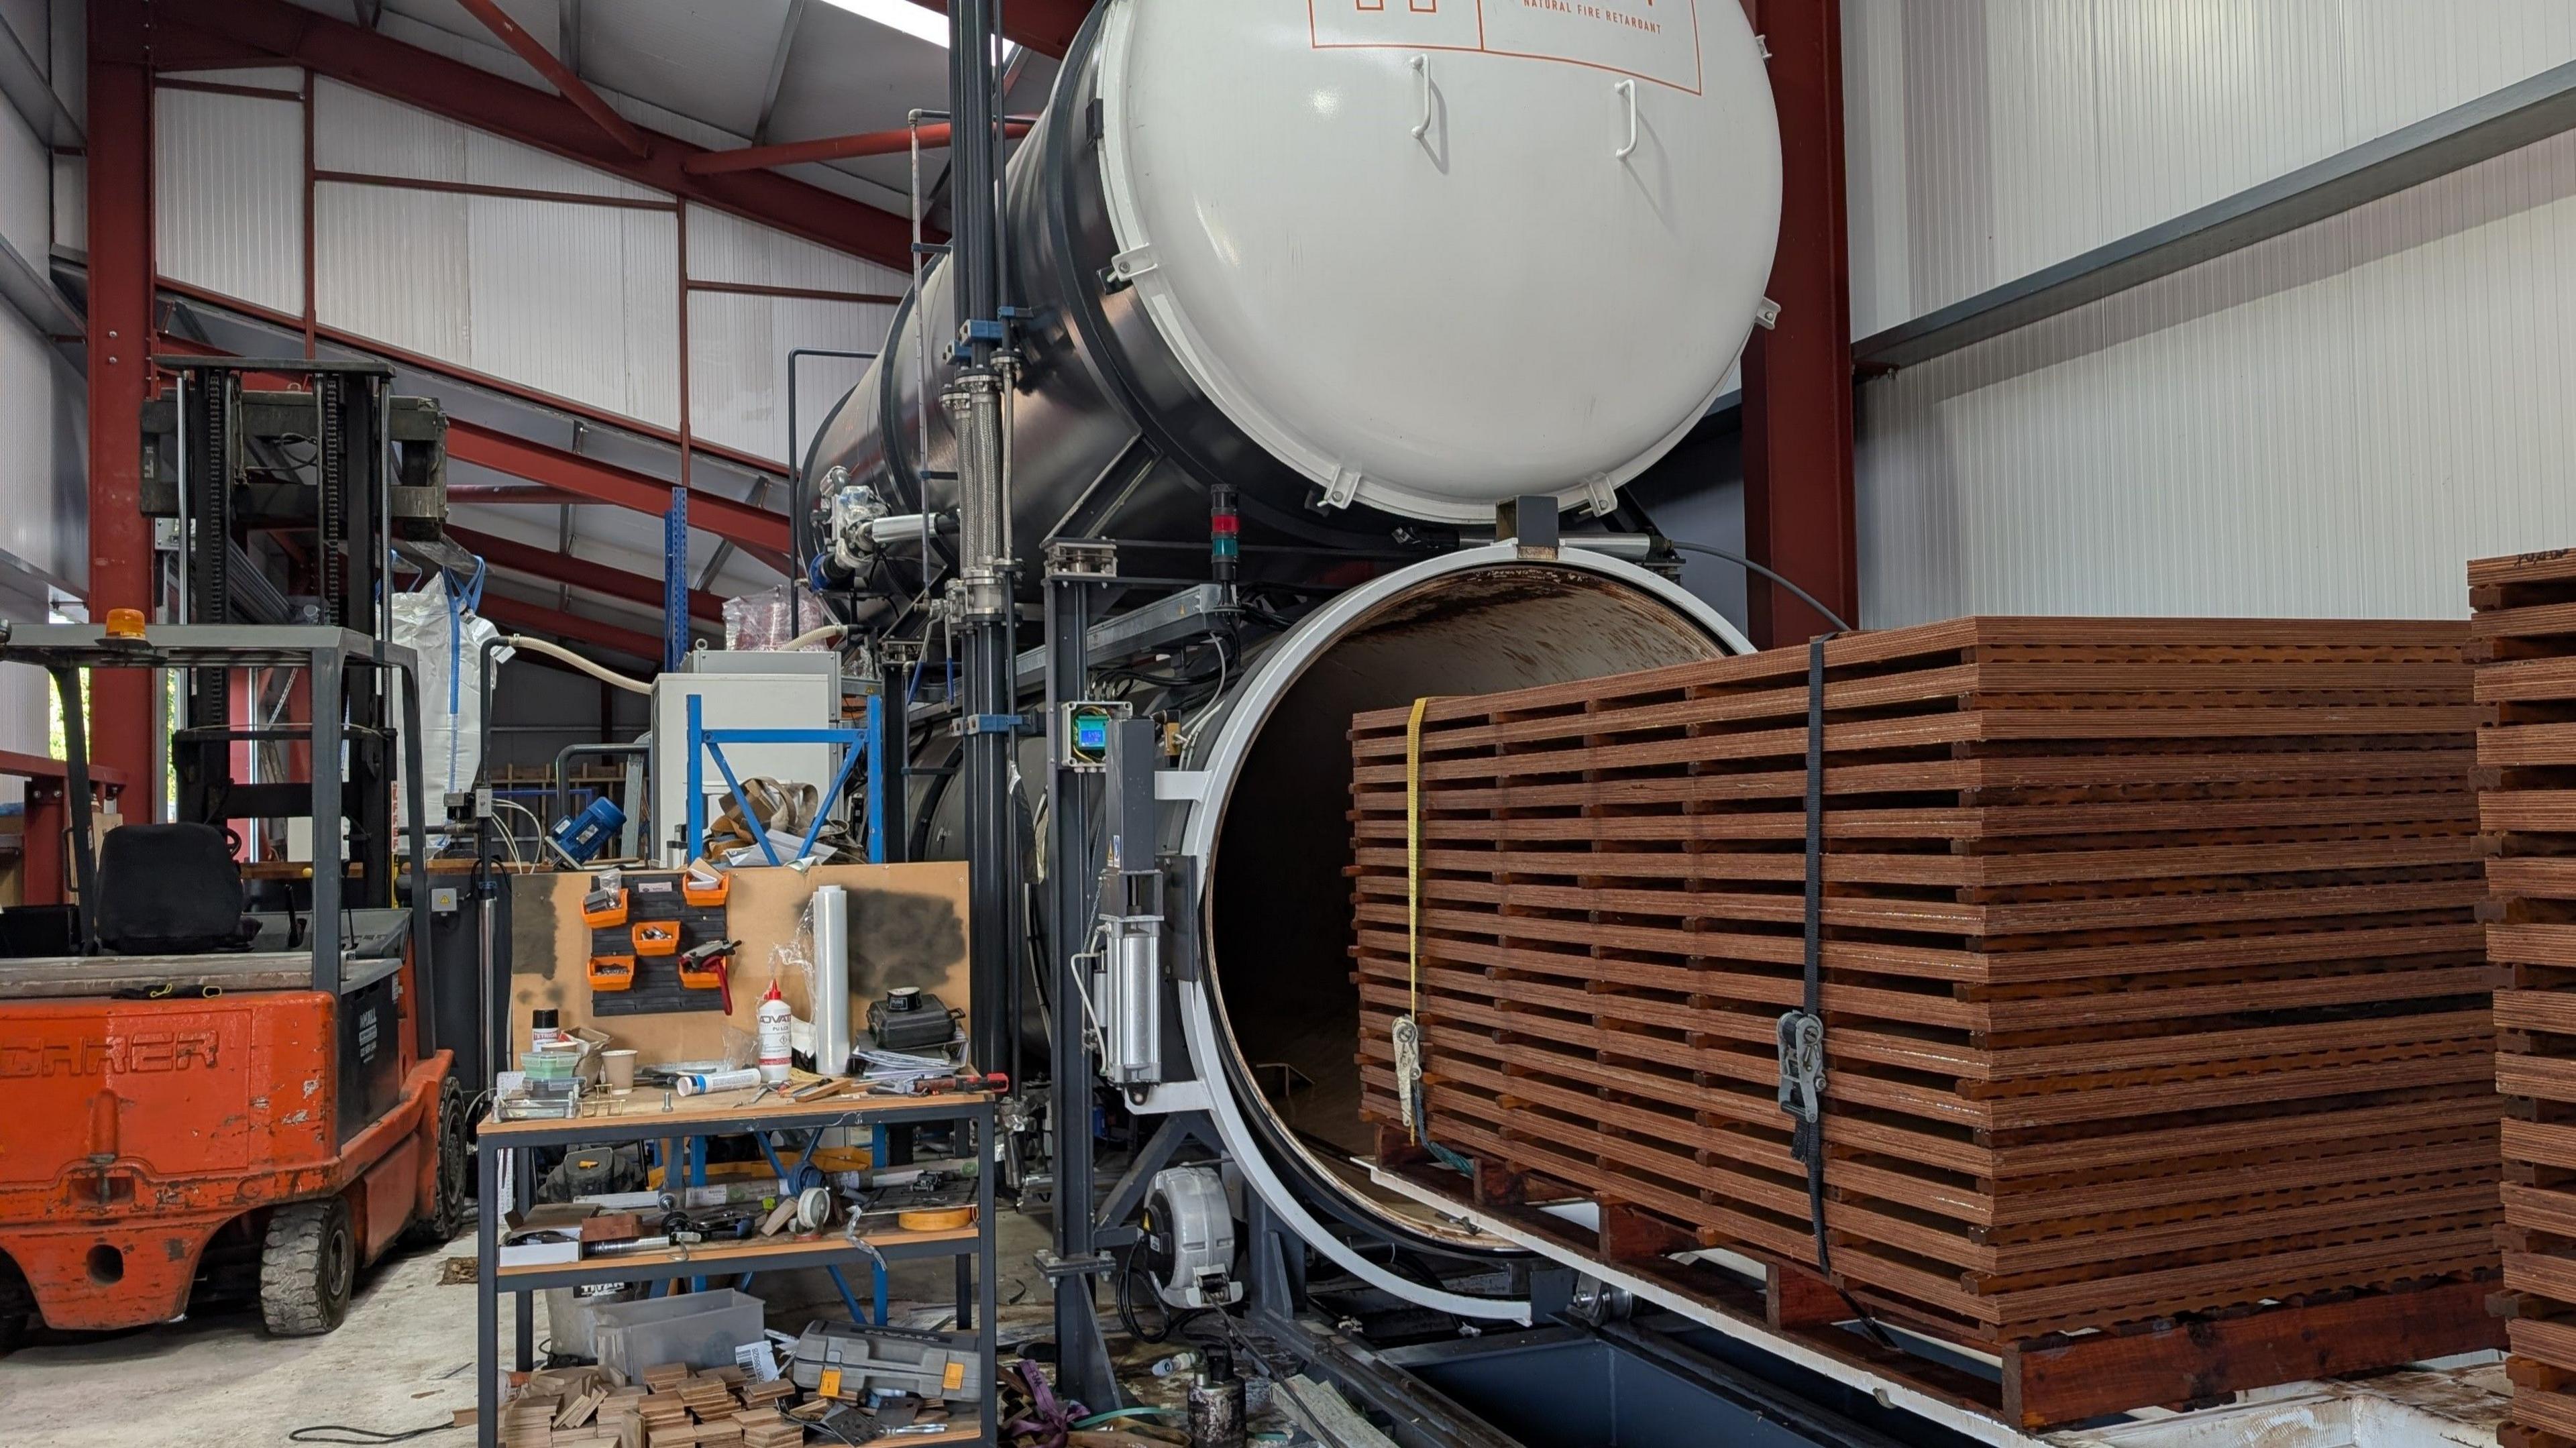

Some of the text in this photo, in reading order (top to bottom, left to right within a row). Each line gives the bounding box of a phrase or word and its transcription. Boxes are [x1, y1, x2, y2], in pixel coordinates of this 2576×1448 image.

[1523, 0, 1662, 34] NATURAL FIRE RETARDANT
